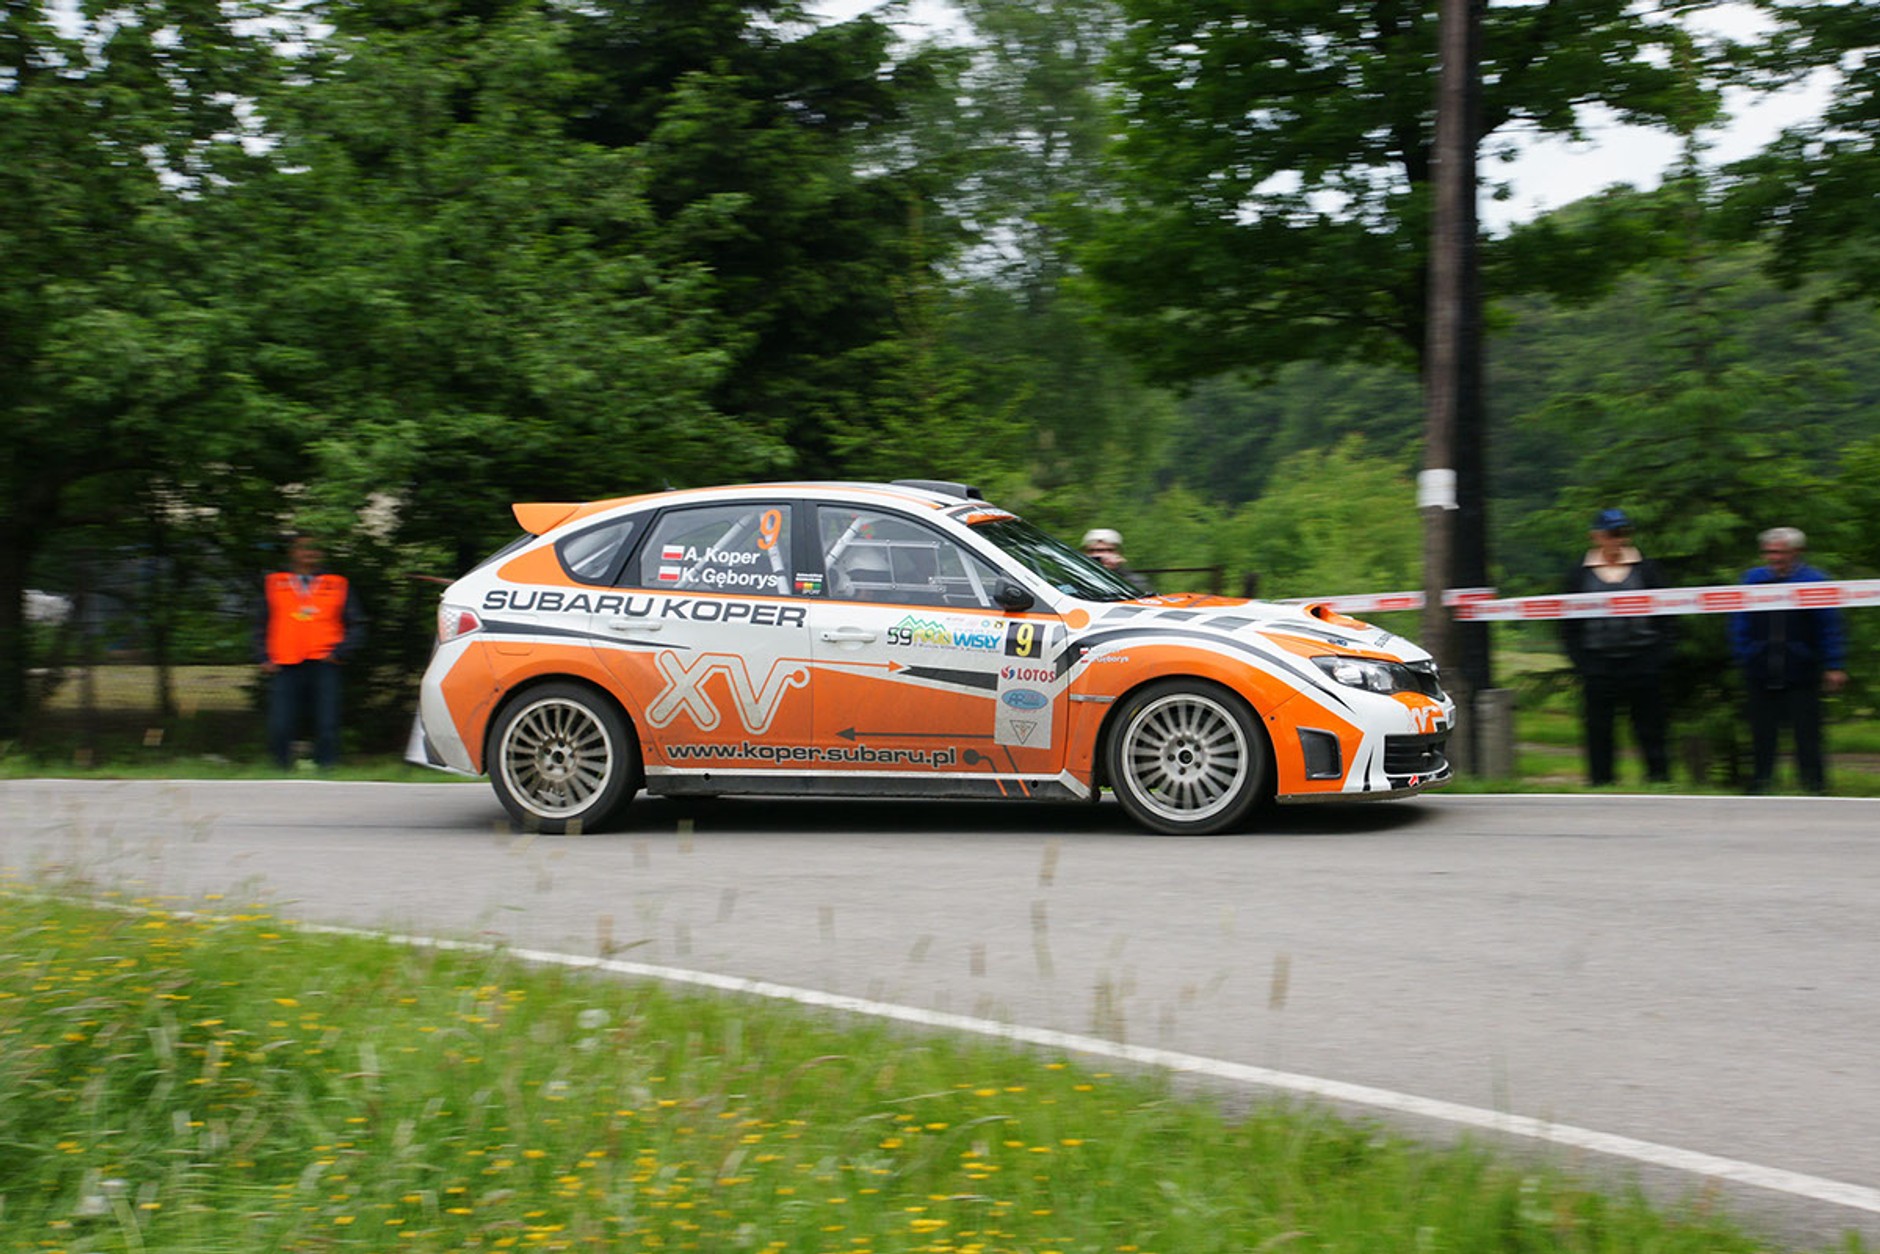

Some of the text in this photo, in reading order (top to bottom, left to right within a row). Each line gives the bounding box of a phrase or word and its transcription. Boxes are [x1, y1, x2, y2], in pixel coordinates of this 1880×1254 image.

[757, 508, 783, 551] 9
[683, 545, 761, 566] A. Koper
[681, 567, 699, 583] K.
[701, 568, 780, 591] Gęborys
[482, 590, 808, 628] SUBARU KOPER
[886, 626, 913, 647] 59
[1015, 623, 1035, 658] 9
[1017, 668, 1056, 684] LOTOS
[645, 649, 811, 735] XV
[667, 742, 956, 768] www.koper.subaru.pl
